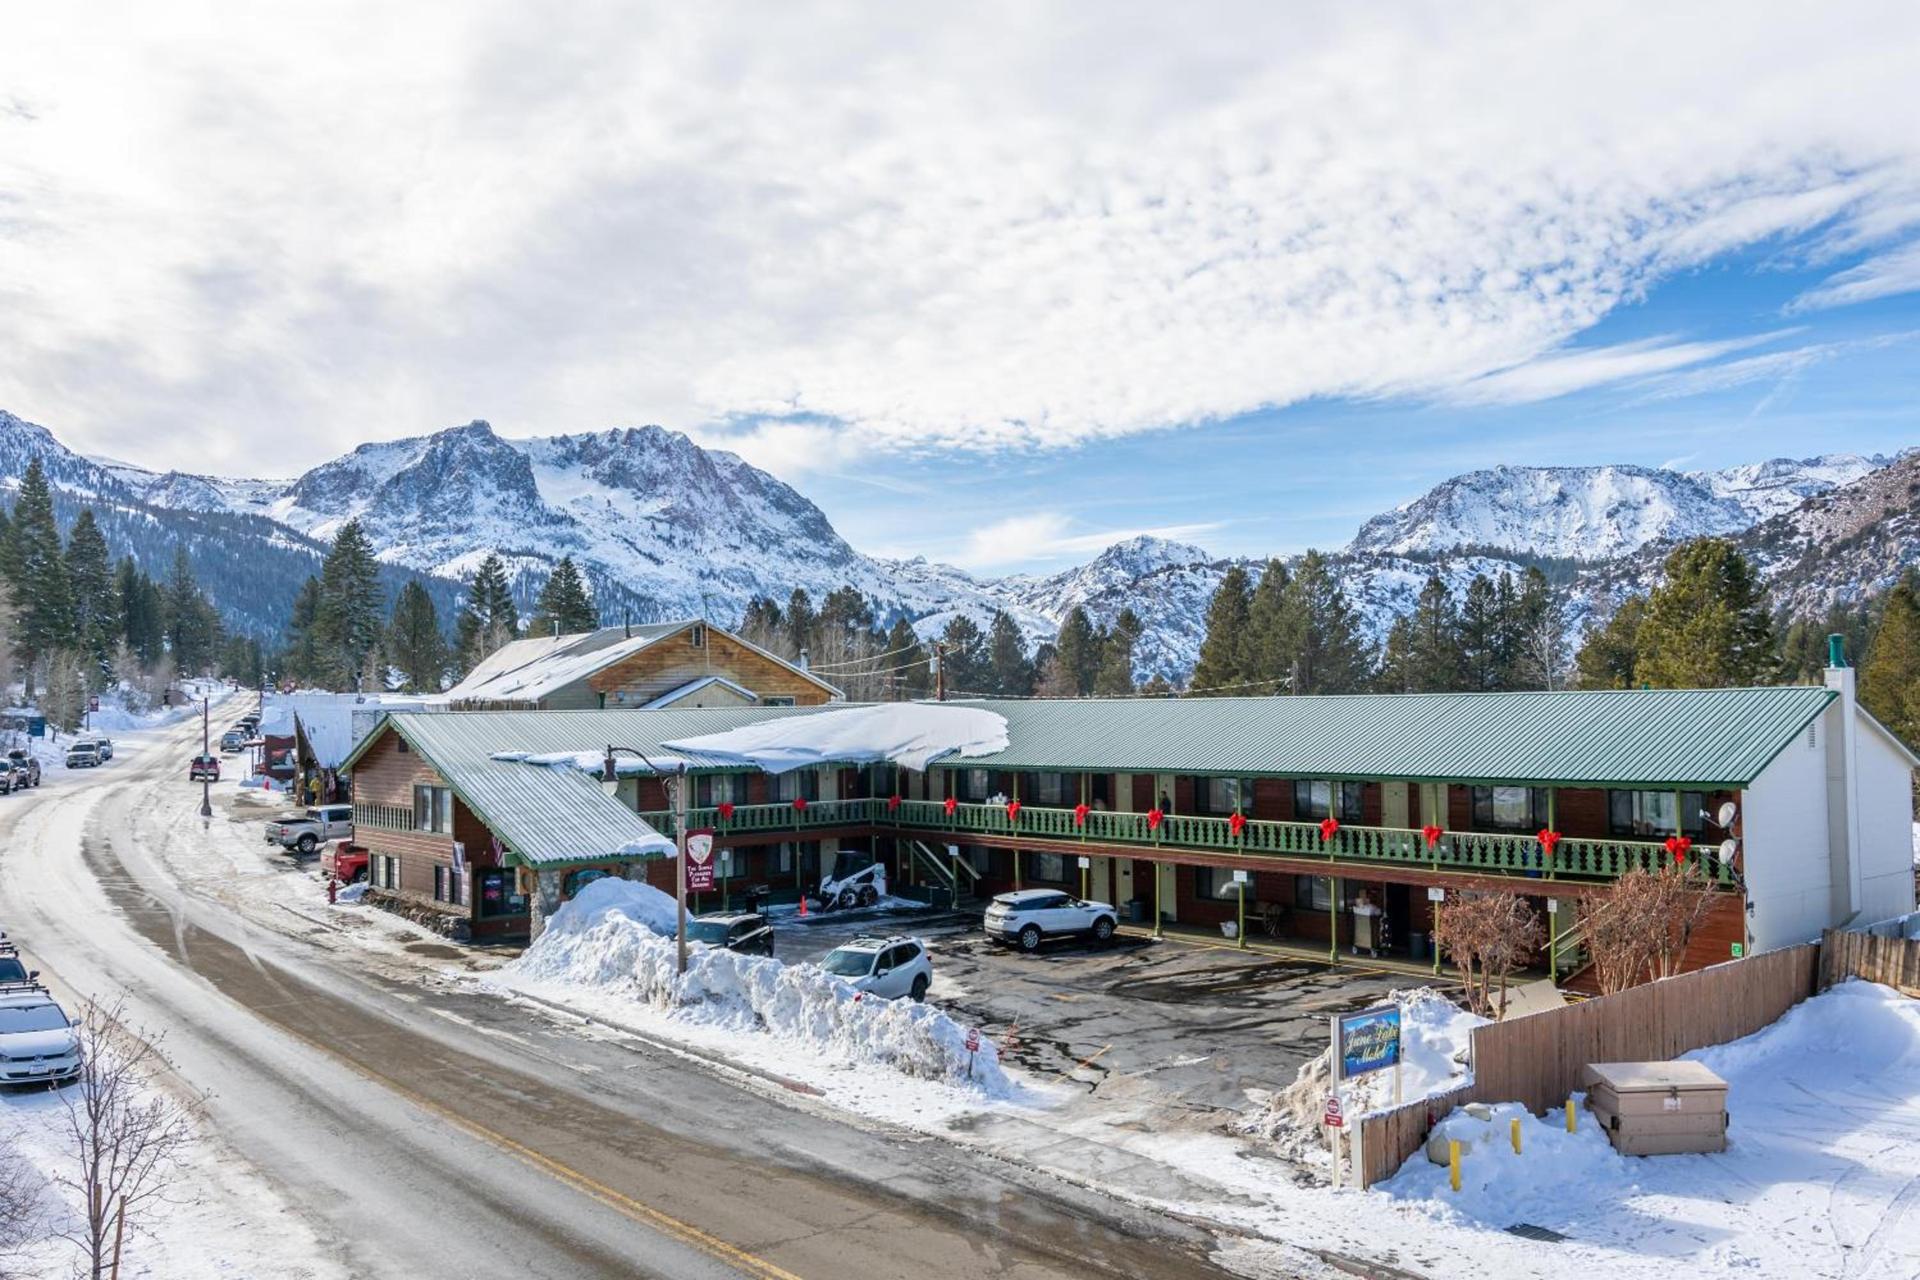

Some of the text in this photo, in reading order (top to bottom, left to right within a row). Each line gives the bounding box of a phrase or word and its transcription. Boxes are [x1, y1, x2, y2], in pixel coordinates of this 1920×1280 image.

[1344, 1023, 1399, 1057] June Lake
[1359, 1041, 1388, 1063] Motel
